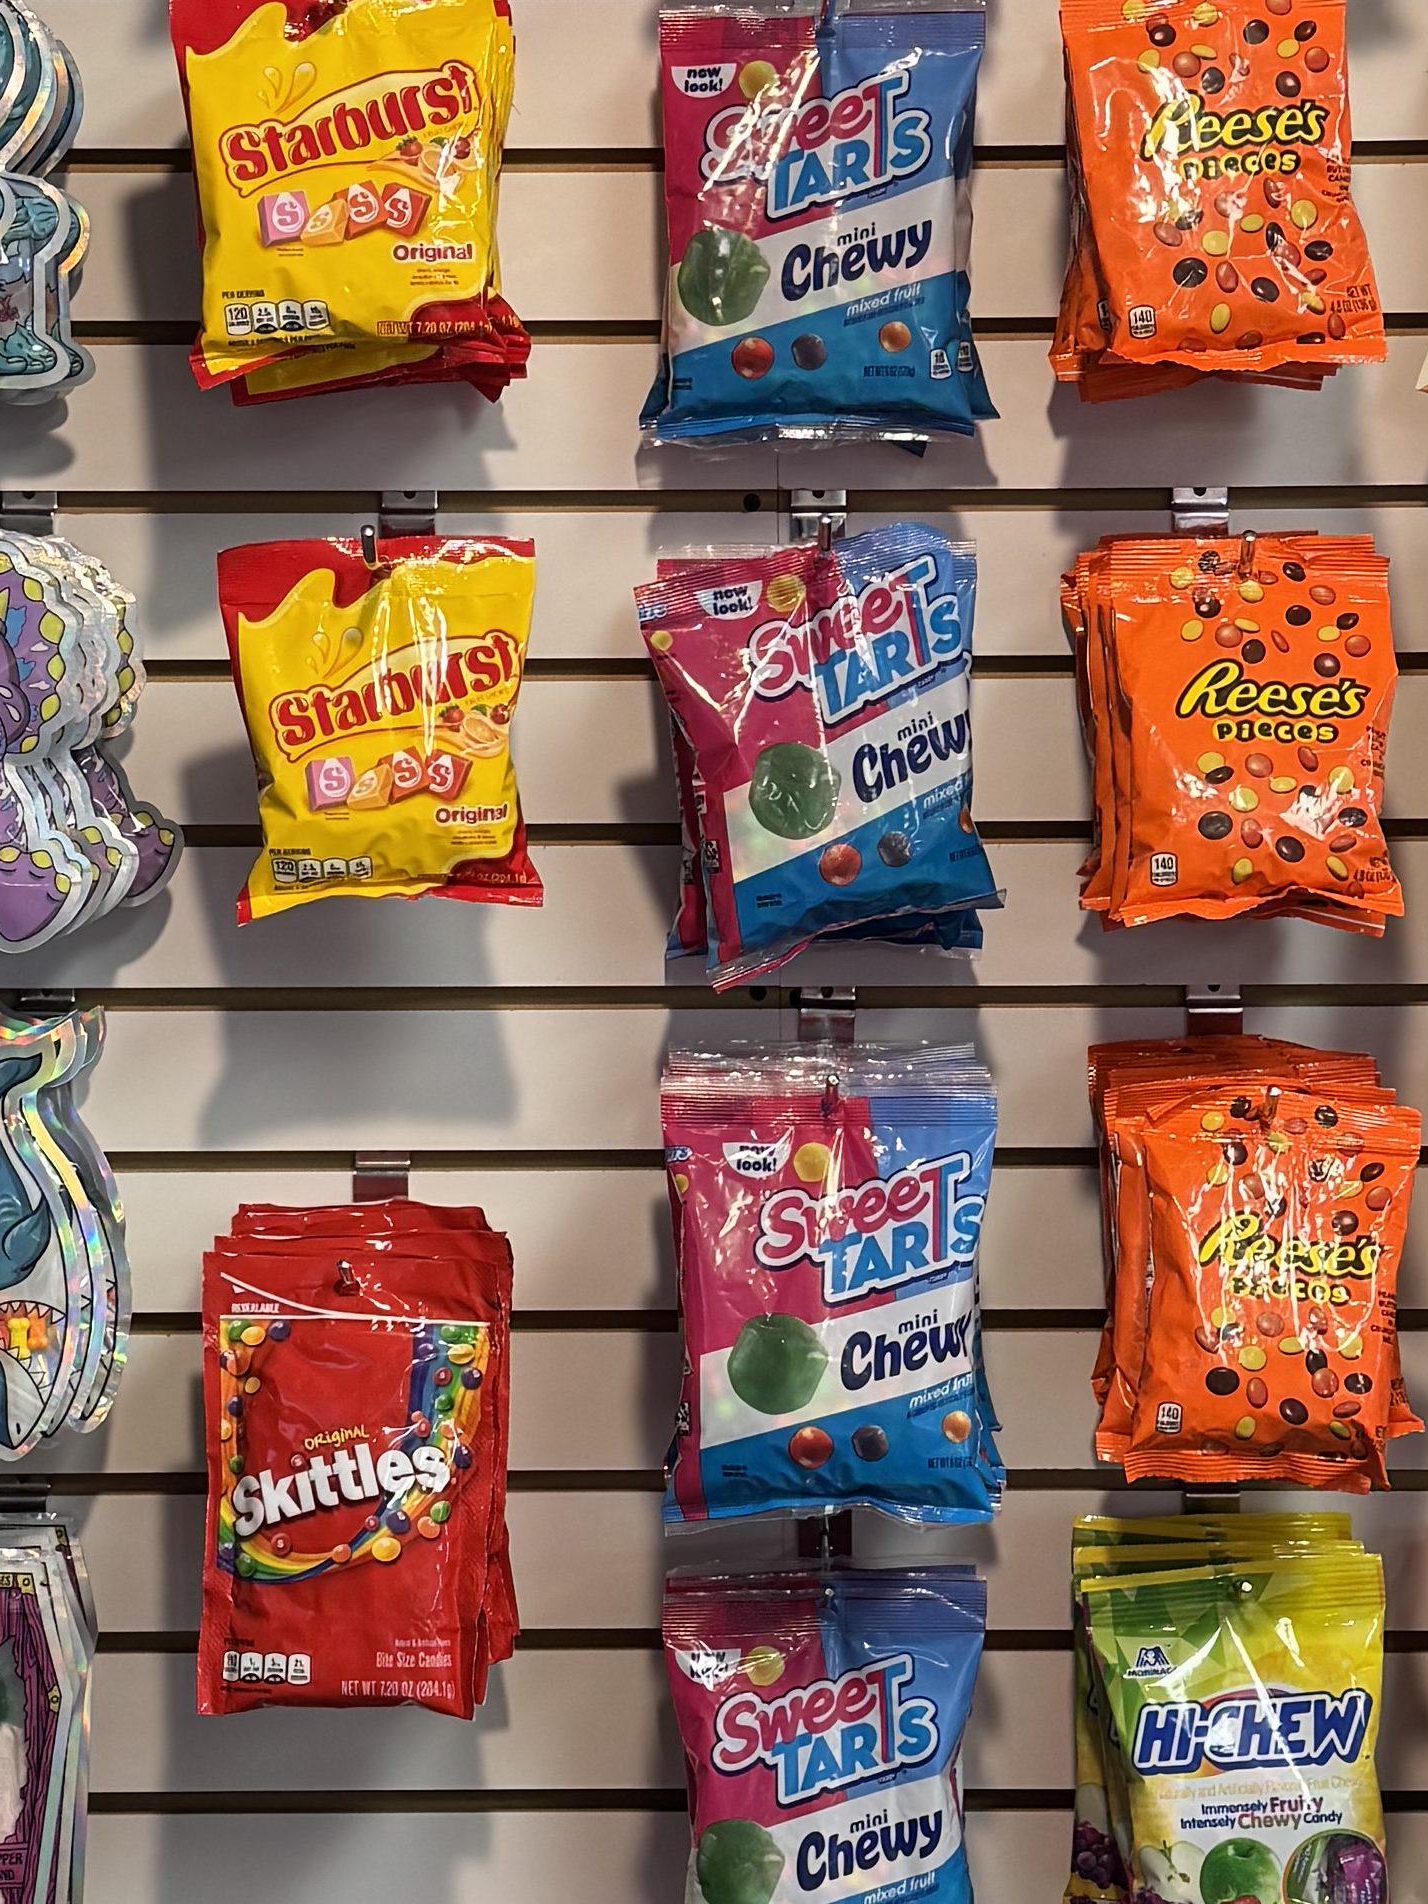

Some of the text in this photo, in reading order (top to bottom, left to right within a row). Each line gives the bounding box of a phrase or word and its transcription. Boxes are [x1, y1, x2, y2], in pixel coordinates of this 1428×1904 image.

[683, 77, 724, 95] look!
[224, 65, 478, 183] Starburst
[392, 243, 474, 266] Original
[781, 219, 933, 302] Chewy
[837, 221, 876, 248] mini
[273, 631, 517, 748] Starburst
[1175, 660, 1371, 718] Reese's
[1211, 720, 1339, 745] pieces
[233, 1443, 451, 1538] Skittles
[1136, 1696, 1369, 1771] HI-CHEW
[1180, 1810, 1344, 1832] Intensely Chewy Candy
[1201, 1801, 1269, 1817] Immensely
[796, 1809, 944, 1892] Chewy
